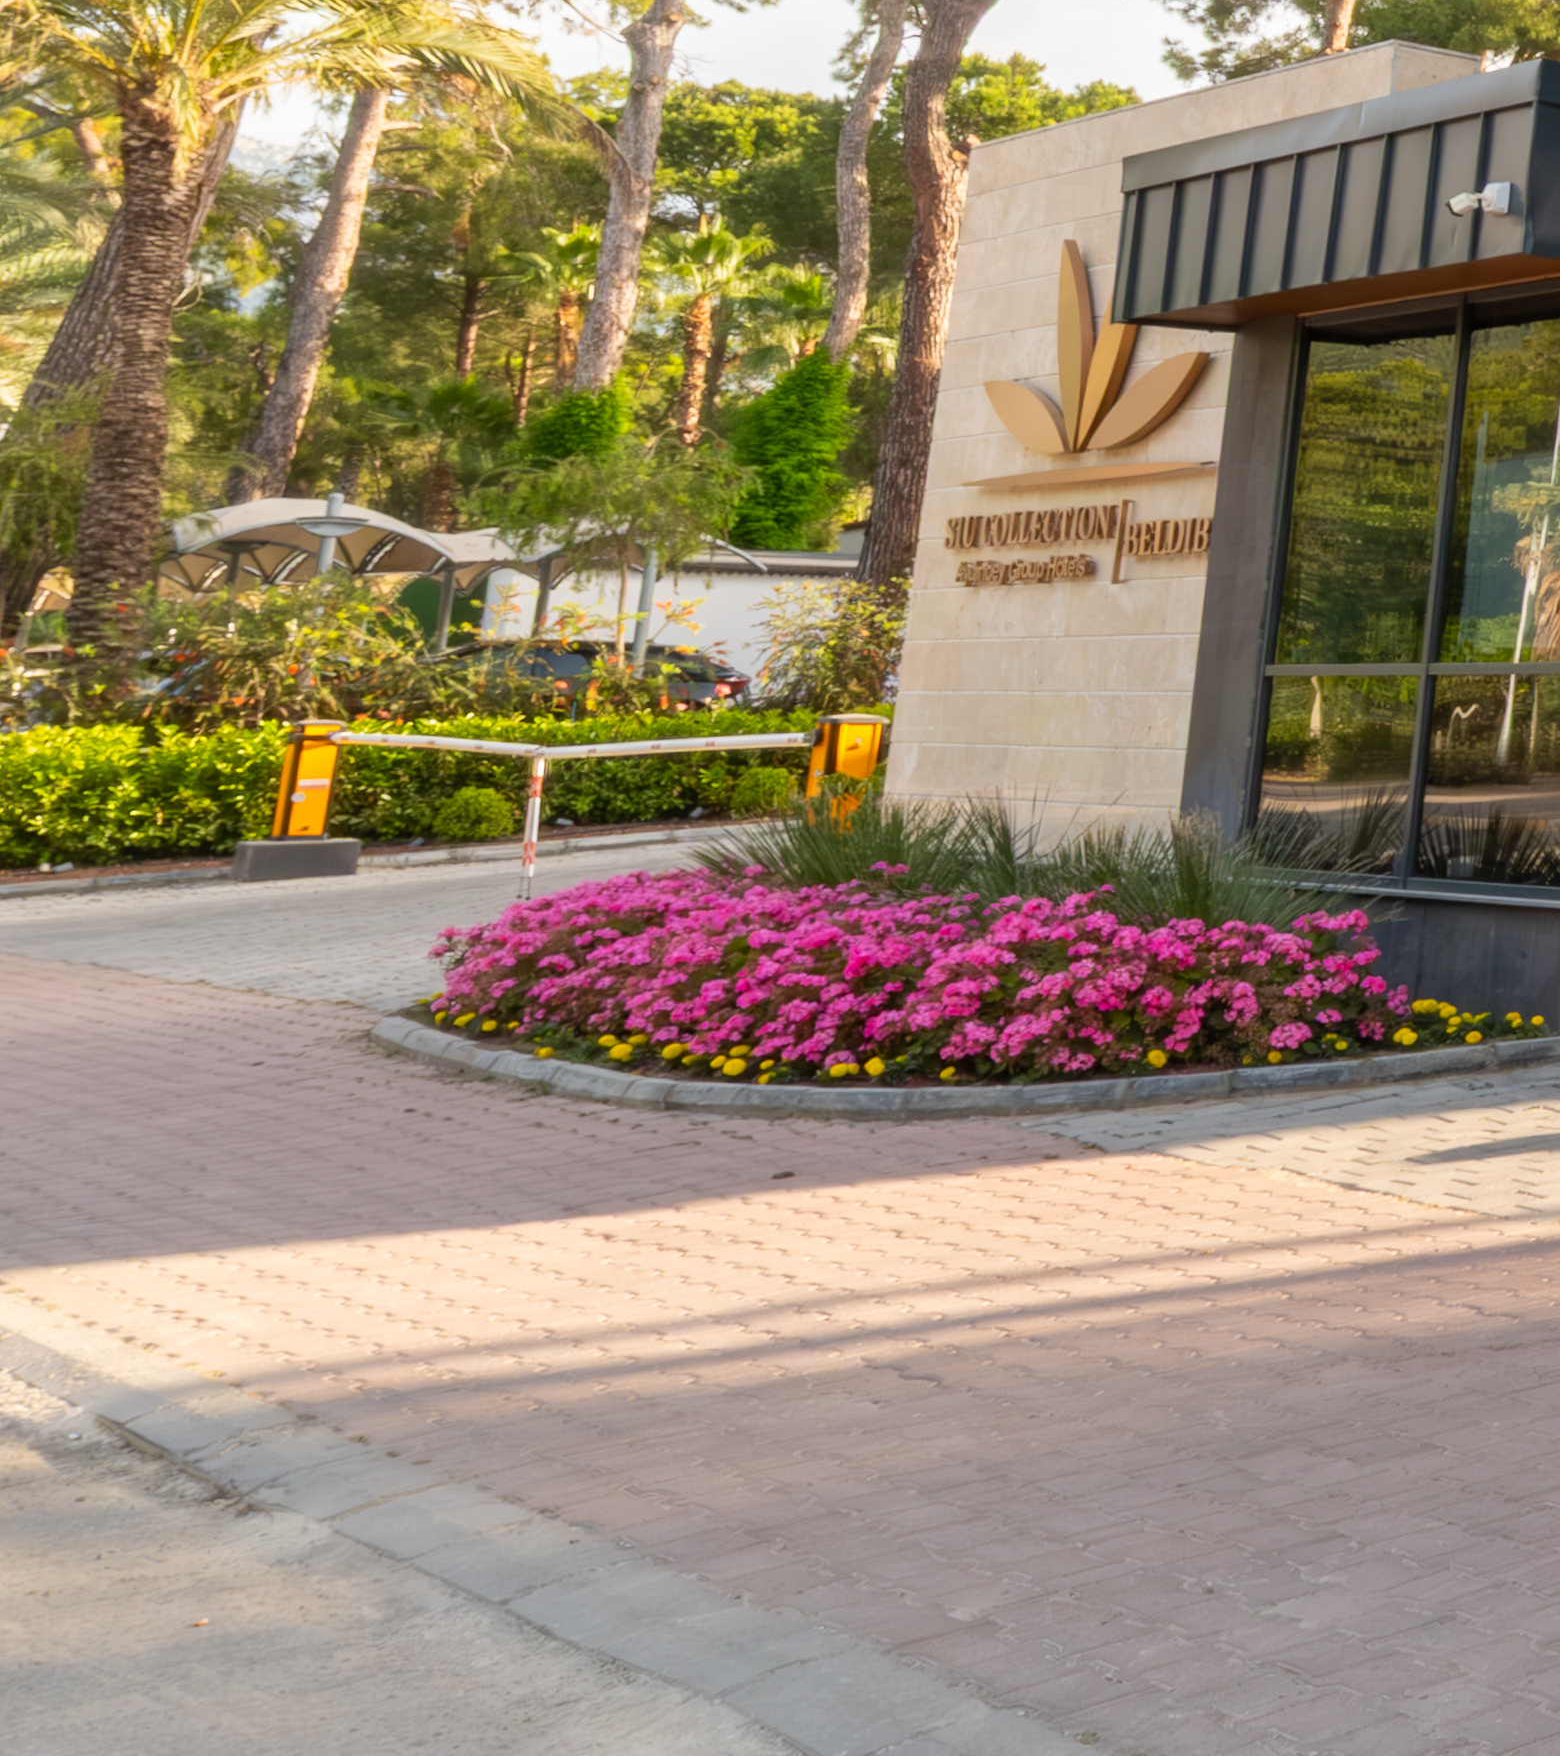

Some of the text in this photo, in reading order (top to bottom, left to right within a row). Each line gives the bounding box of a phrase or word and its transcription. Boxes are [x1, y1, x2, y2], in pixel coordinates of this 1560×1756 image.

[981, 504, 1119, 546] COLLECTION
[1122, 517, 1211, 556] BELDIB
[1009, 558, 1050, 584] Group
[1049, 553, 1097, 580] Hotels
